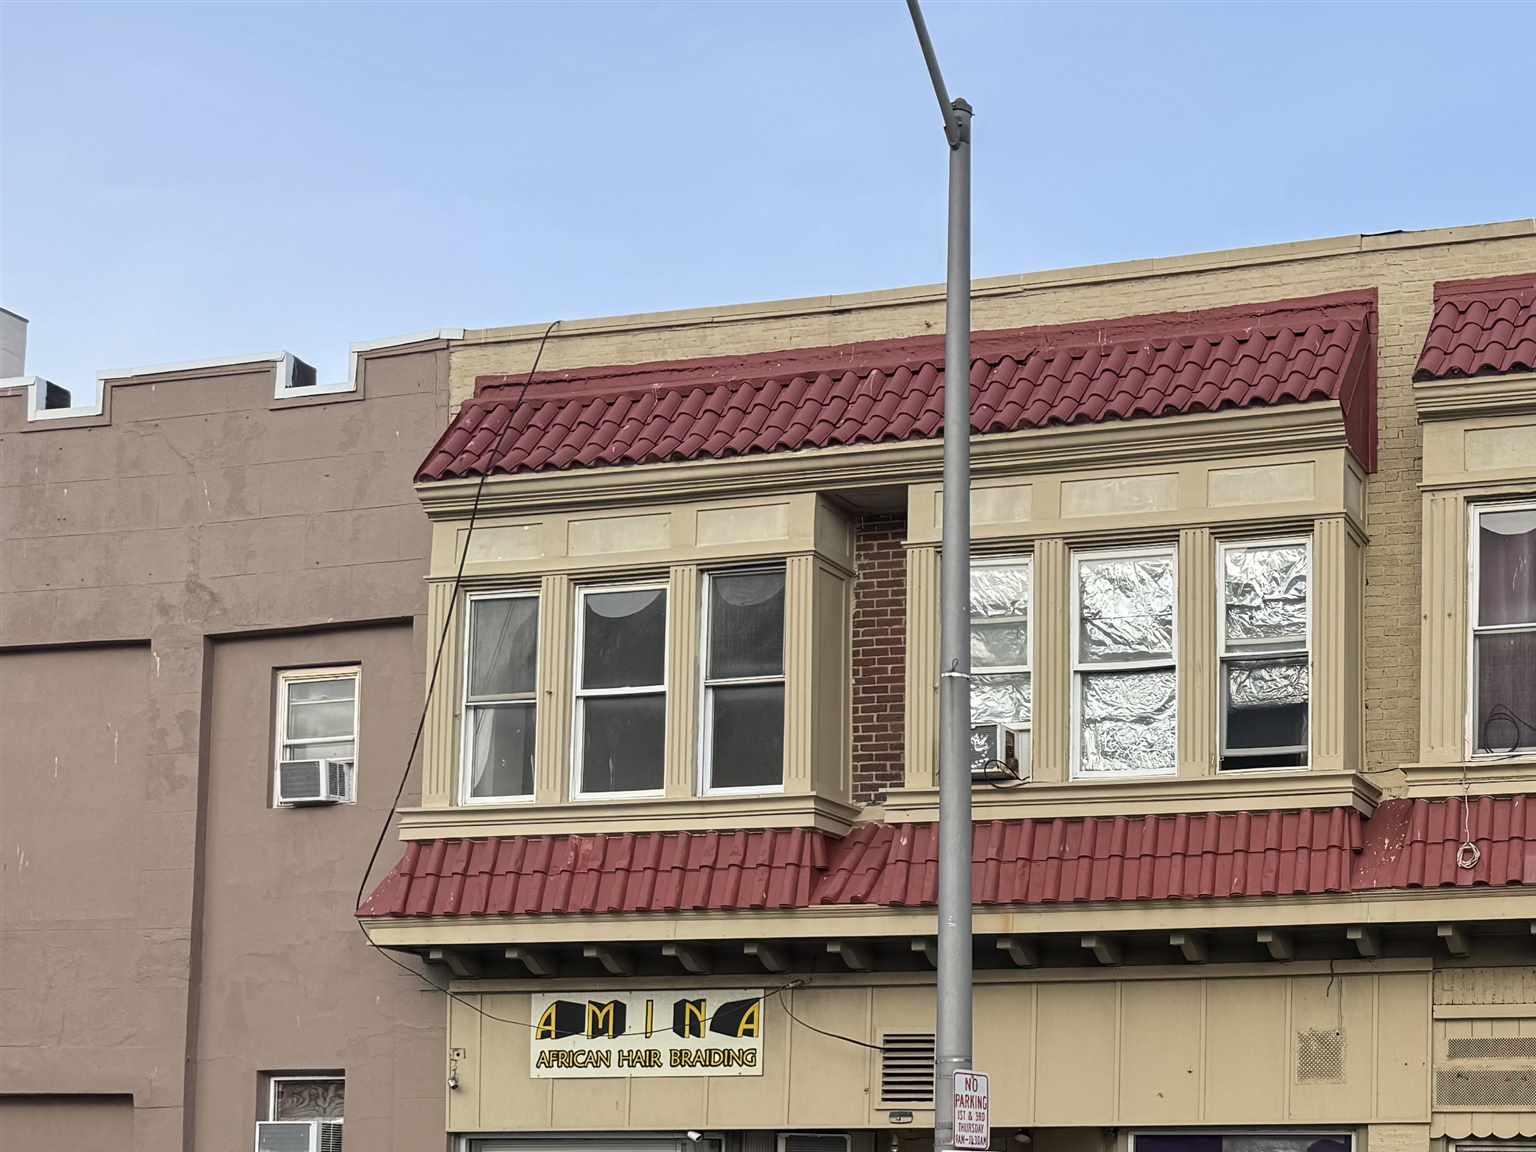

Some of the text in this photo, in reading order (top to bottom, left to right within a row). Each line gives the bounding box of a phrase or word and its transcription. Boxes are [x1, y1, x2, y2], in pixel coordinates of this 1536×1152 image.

[535, 999, 762, 1040] AMINA
[536, 1048, 757, 1068] AFRICAN HAIR BRAIDING
[965, 1077, 978, 1092] NO
[955, 1093, 988, 1110] PARKING
[958, 1122, 984, 1134] THURSDAY
